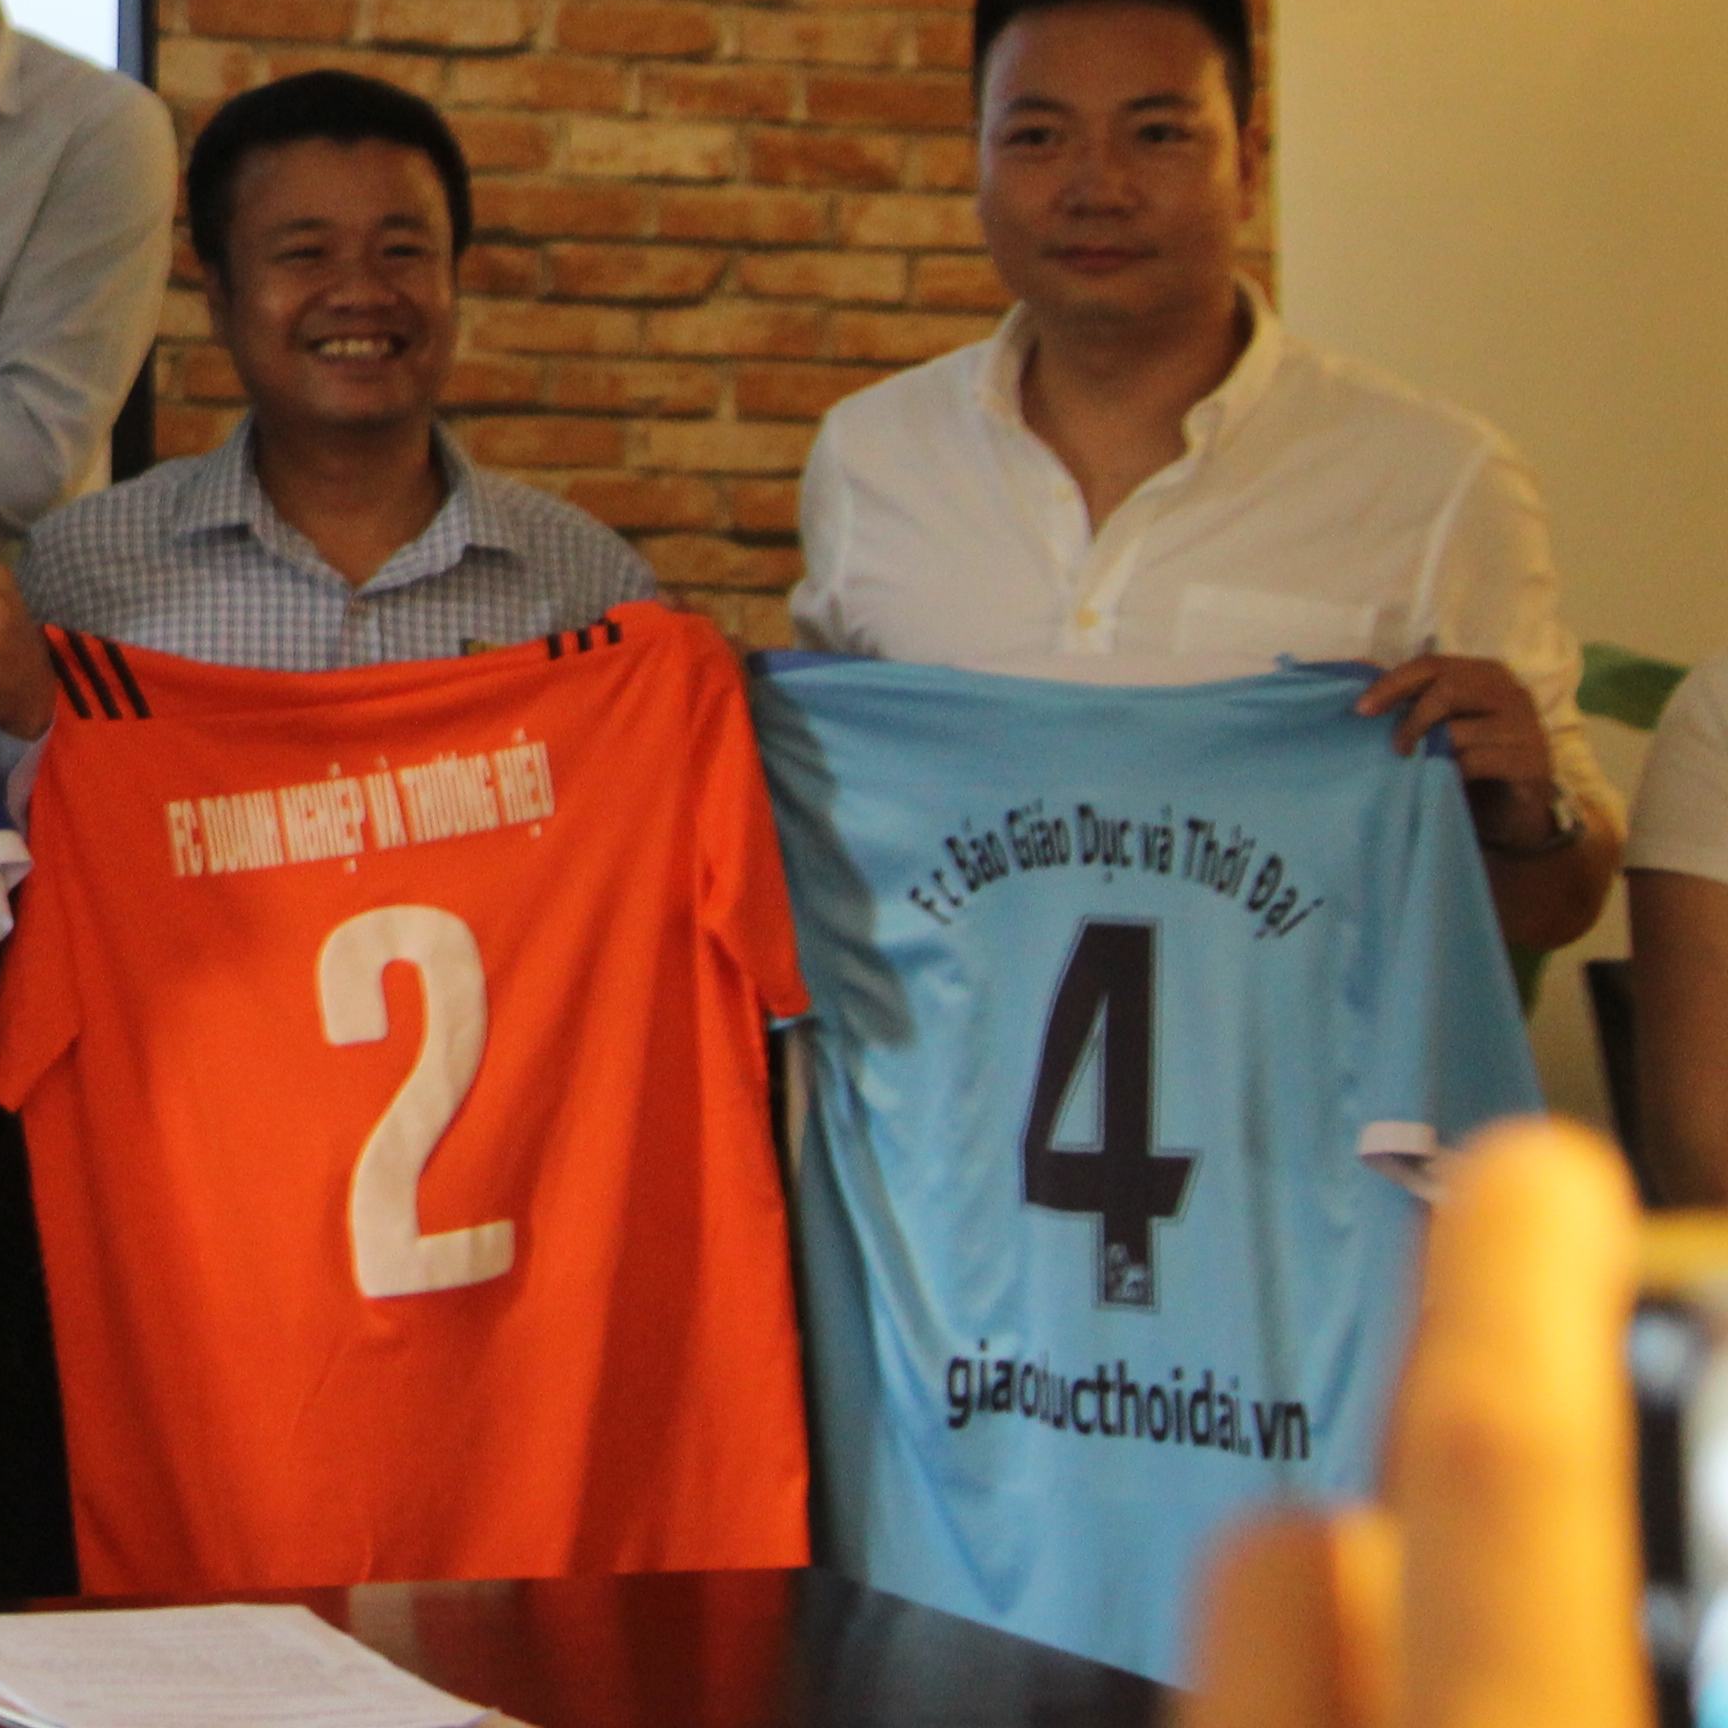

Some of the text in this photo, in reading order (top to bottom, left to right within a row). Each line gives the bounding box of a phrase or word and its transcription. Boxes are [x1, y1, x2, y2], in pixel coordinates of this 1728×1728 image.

[1076, 803, 1133, 884] Dục
[316, 903, 516, 1299] 2
[1018, 913, 1207, 1312] 4
